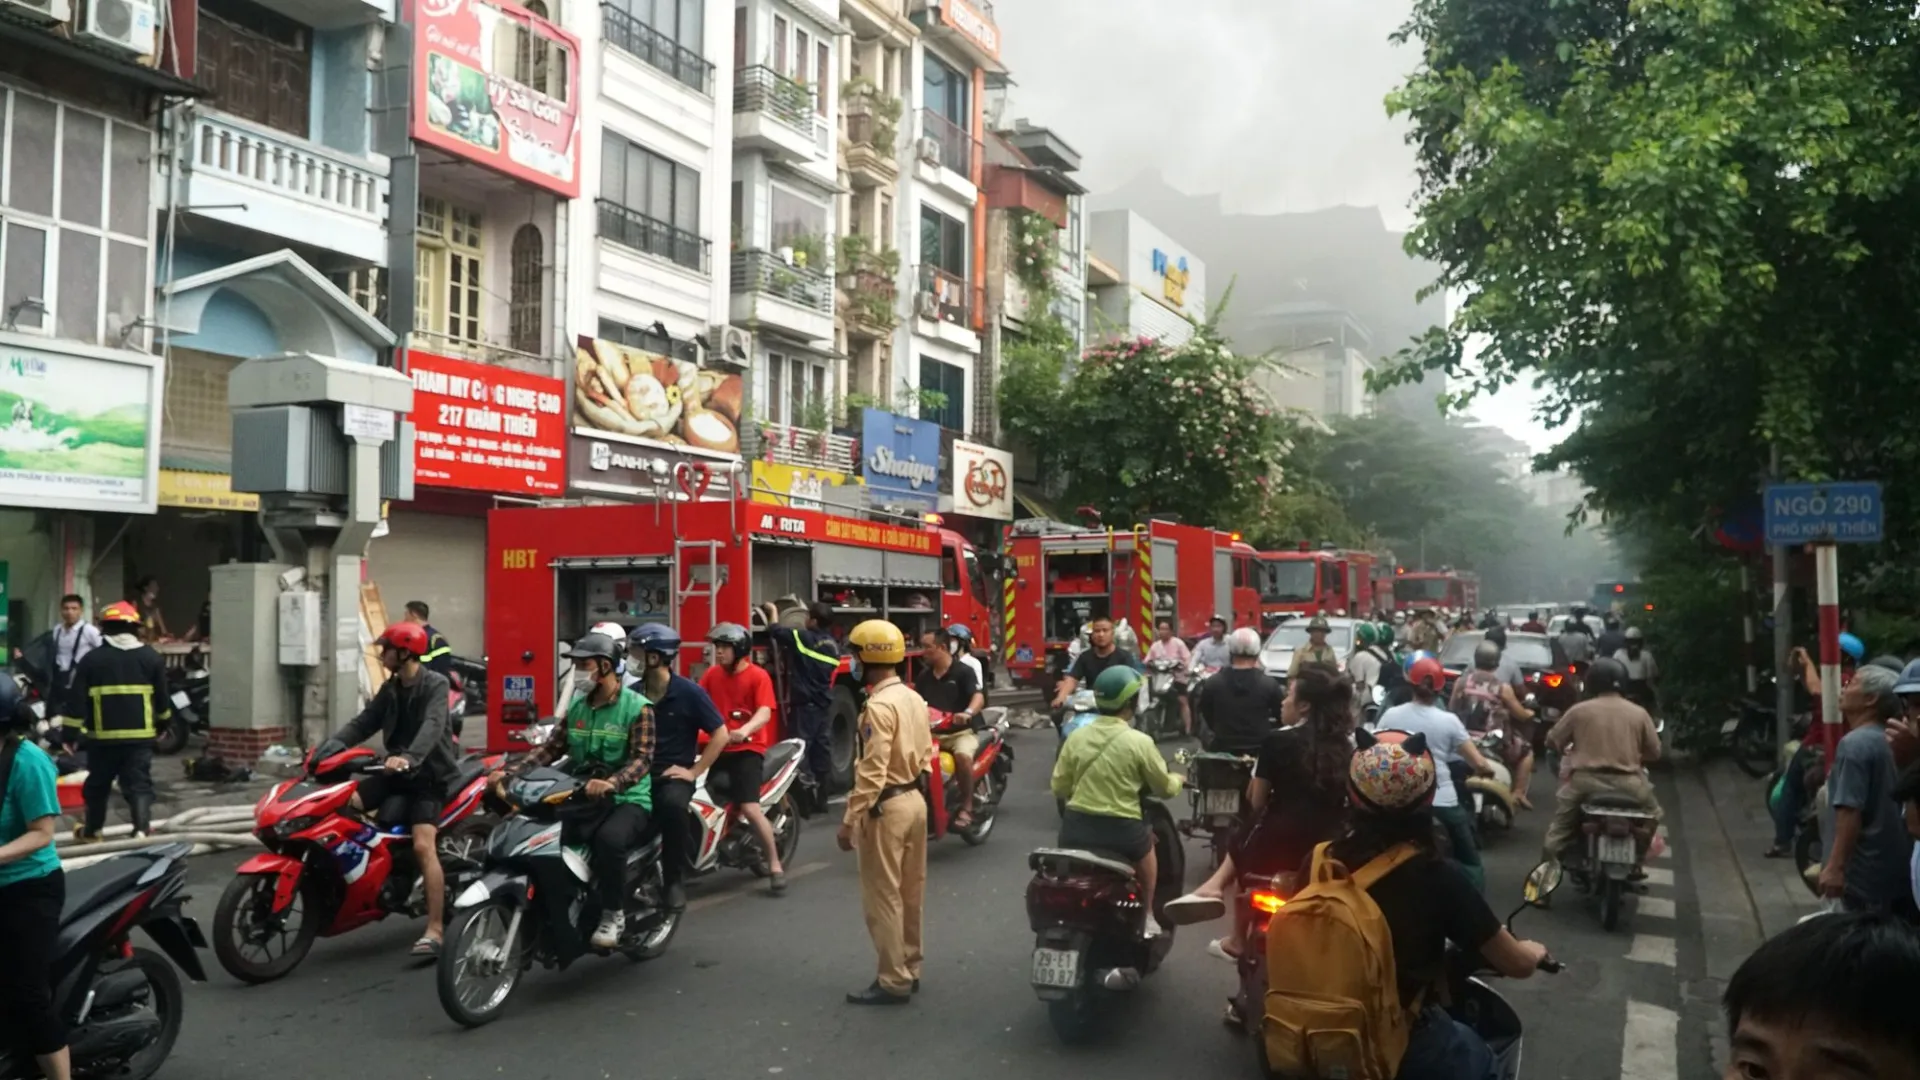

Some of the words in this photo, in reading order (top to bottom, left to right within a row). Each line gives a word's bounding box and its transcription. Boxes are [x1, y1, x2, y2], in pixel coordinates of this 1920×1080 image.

[537, 391, 561, 414] CAO
[438, 403, 464, 427] 217
[870, 445, 936, 488] Shaiya
[1833, 494, 1872, 515] 290
[503, 549, 538, 569] HBT
